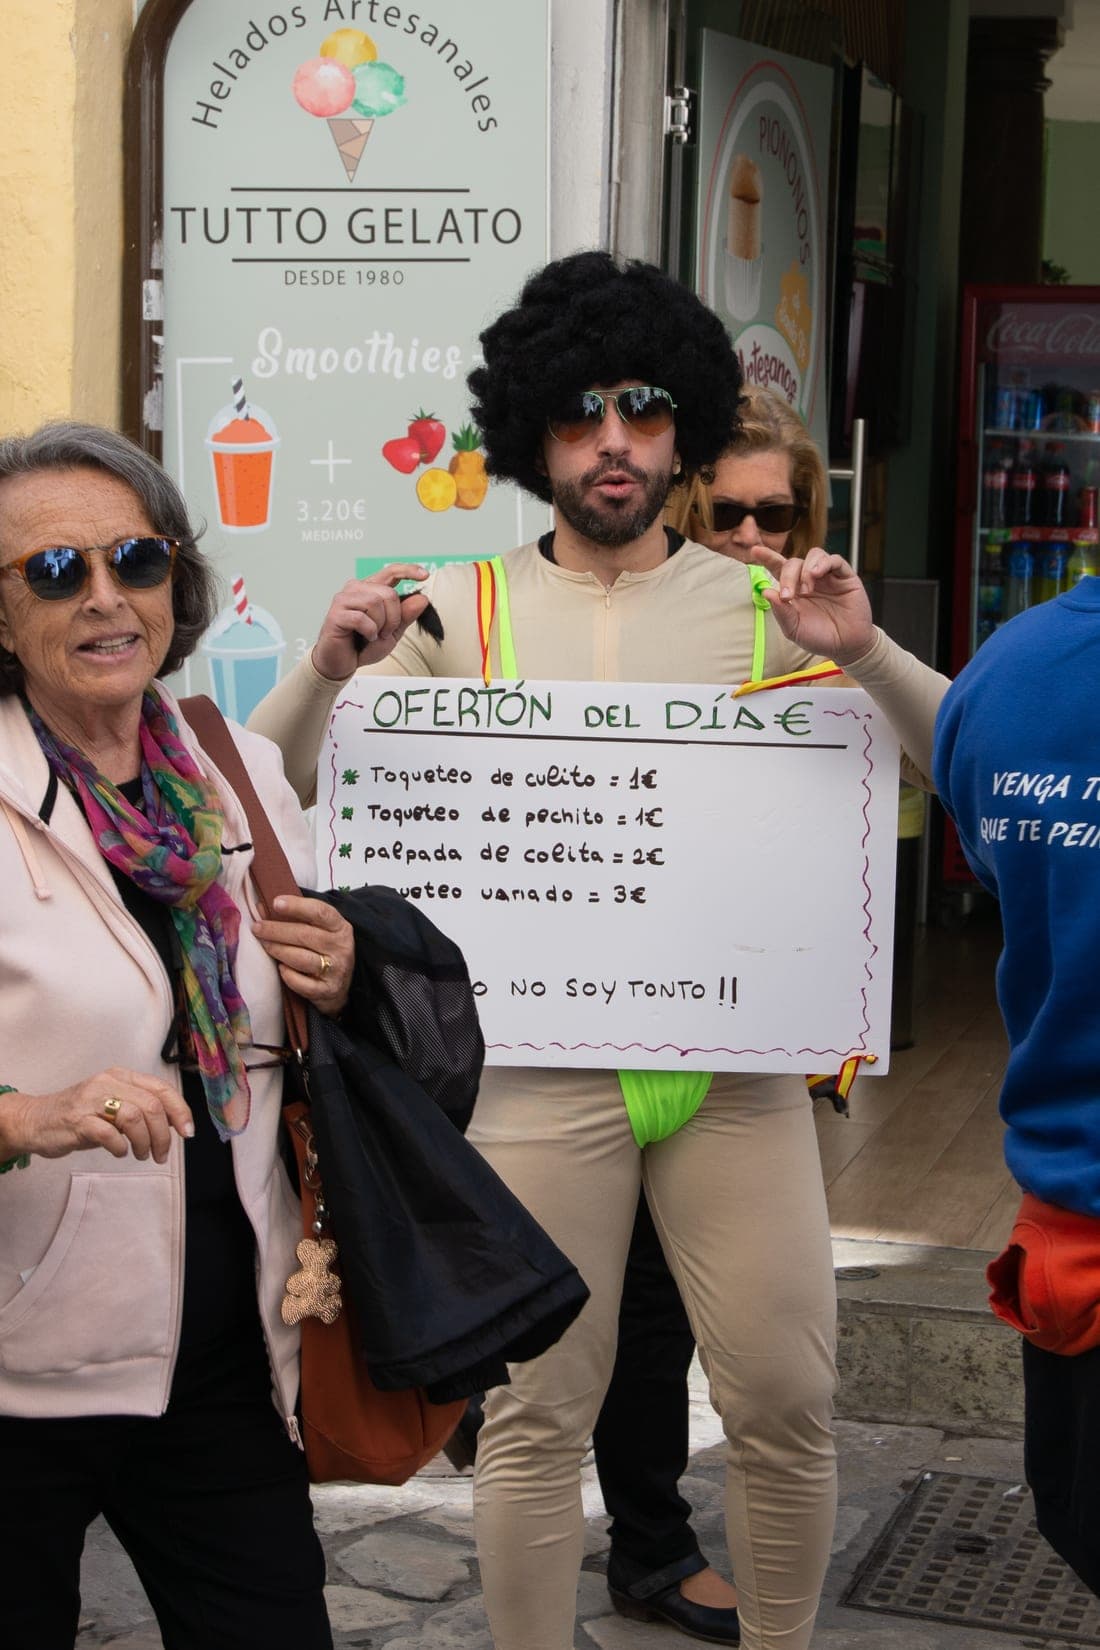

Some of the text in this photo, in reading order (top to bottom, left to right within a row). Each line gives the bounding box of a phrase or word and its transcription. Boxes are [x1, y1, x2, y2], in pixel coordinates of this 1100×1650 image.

[192, 0, 498, 132] Helados Artesanales
[760, 116, 811, 265] PIONONOS
[170, 207, 522, 245] TUTTO GELATO
[284, 270, 405, 286] DESDE 1980
[251, 326, 463, 381] Smoothies
[297, 499, 367, 521] 3.20€
[301, 529, 364, 542] MEDIANO
[373, 680, 552, 728] OFERTÓN
[584, 704, 641, 728] DEL
[370, 765, 473, 791] Toqueteo
[491, 768, 514, 786] de
[525, 765, 596, 787] culito
[992, 772, 1100, 805] VENGA T
[367, 804, 460, 827] Toqueteo
[481, 807, 511, 823] de
[526, 807, 604, 827] pechito
[980, 817, 1010, 845] QUE
[1017, 820, 1042, 842] TE
[364, 841, 463, 865] palpada
[480, 843, 510, 863] de
[524, 843, 604, 864] colita
[400, 882, 463, 900] ueteo
[481, 884, 573, 902] variado
[511, 979, 546, 997] NO
[566, 978, 617, 1005] SOY
